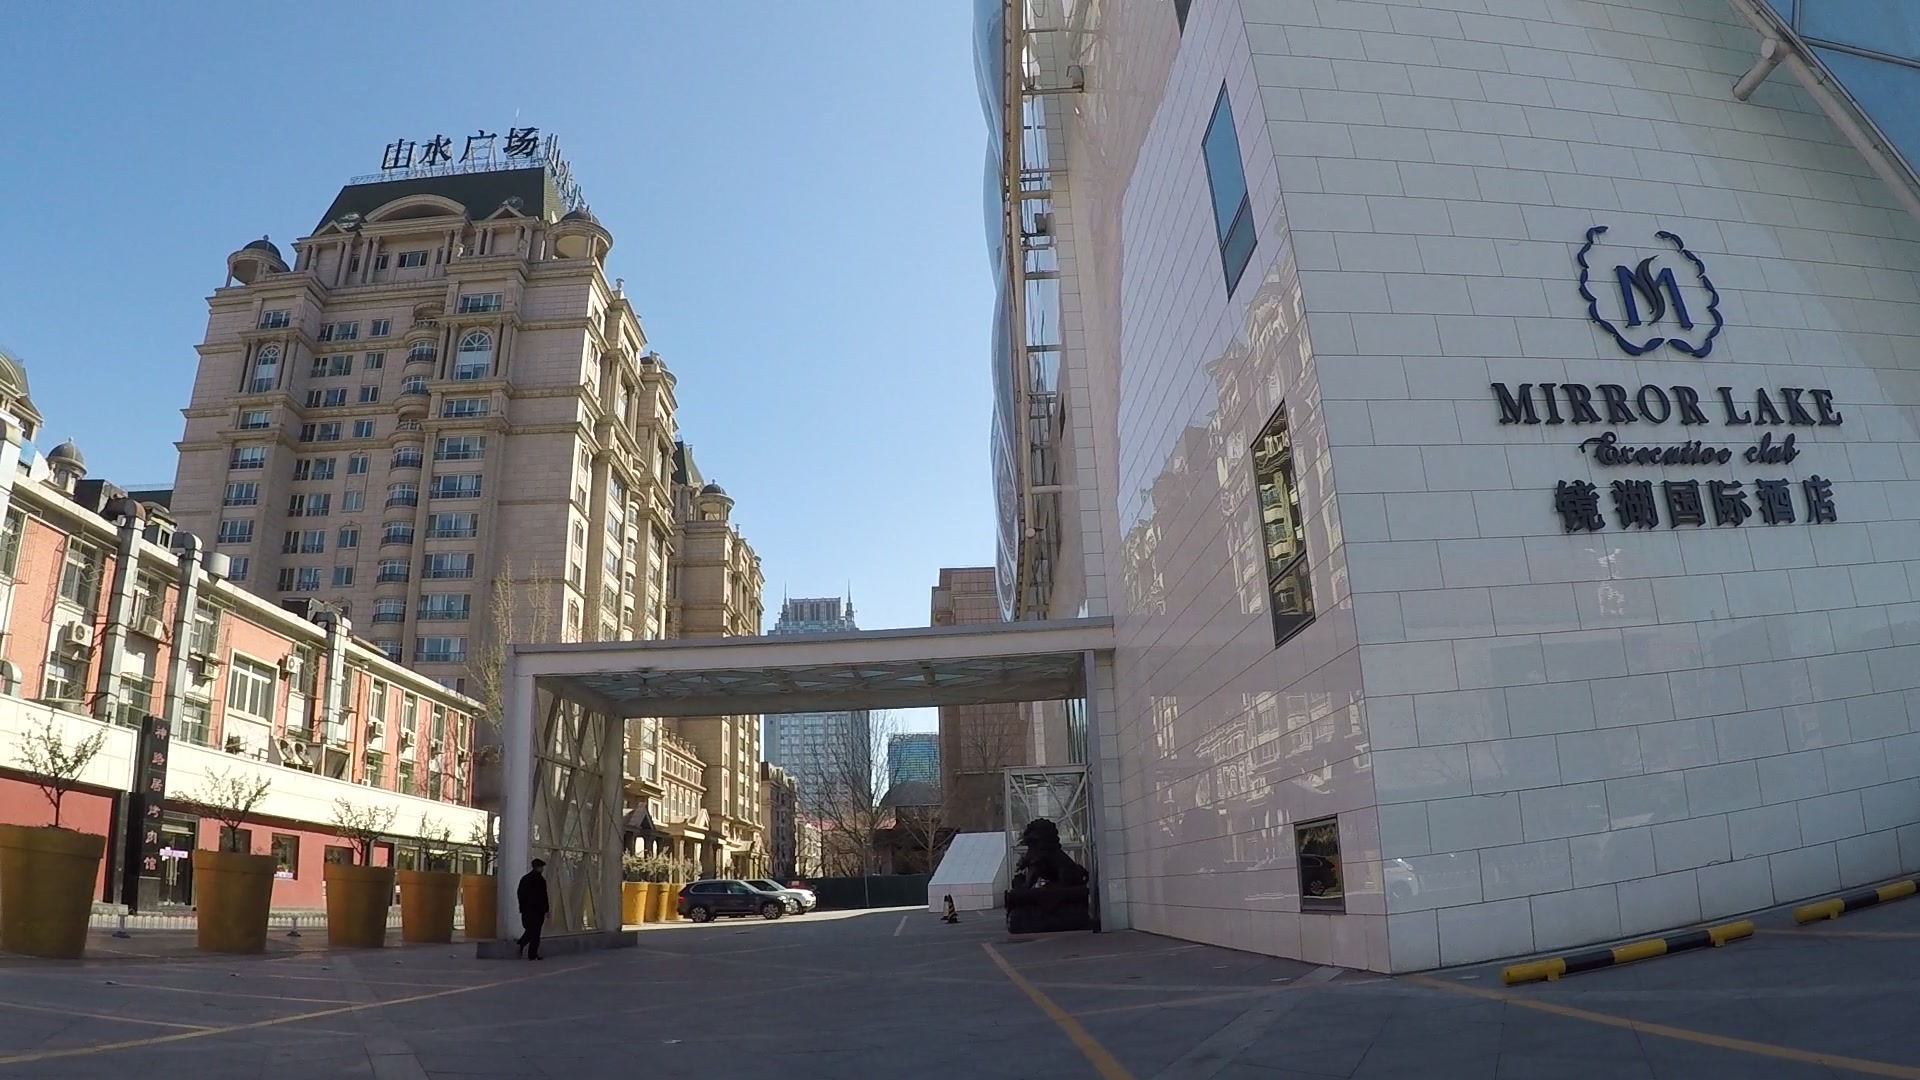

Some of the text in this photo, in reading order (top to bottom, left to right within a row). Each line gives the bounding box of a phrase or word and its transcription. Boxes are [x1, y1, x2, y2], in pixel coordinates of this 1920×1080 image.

[381, 126, 540, 170] 山水广场
[1490, 382, 1843, 426] MIRROR LAKE
[1578, 431, 1801, 467] Executive club
[1554, 474, 1838, 533] 镜湖国际酒店
